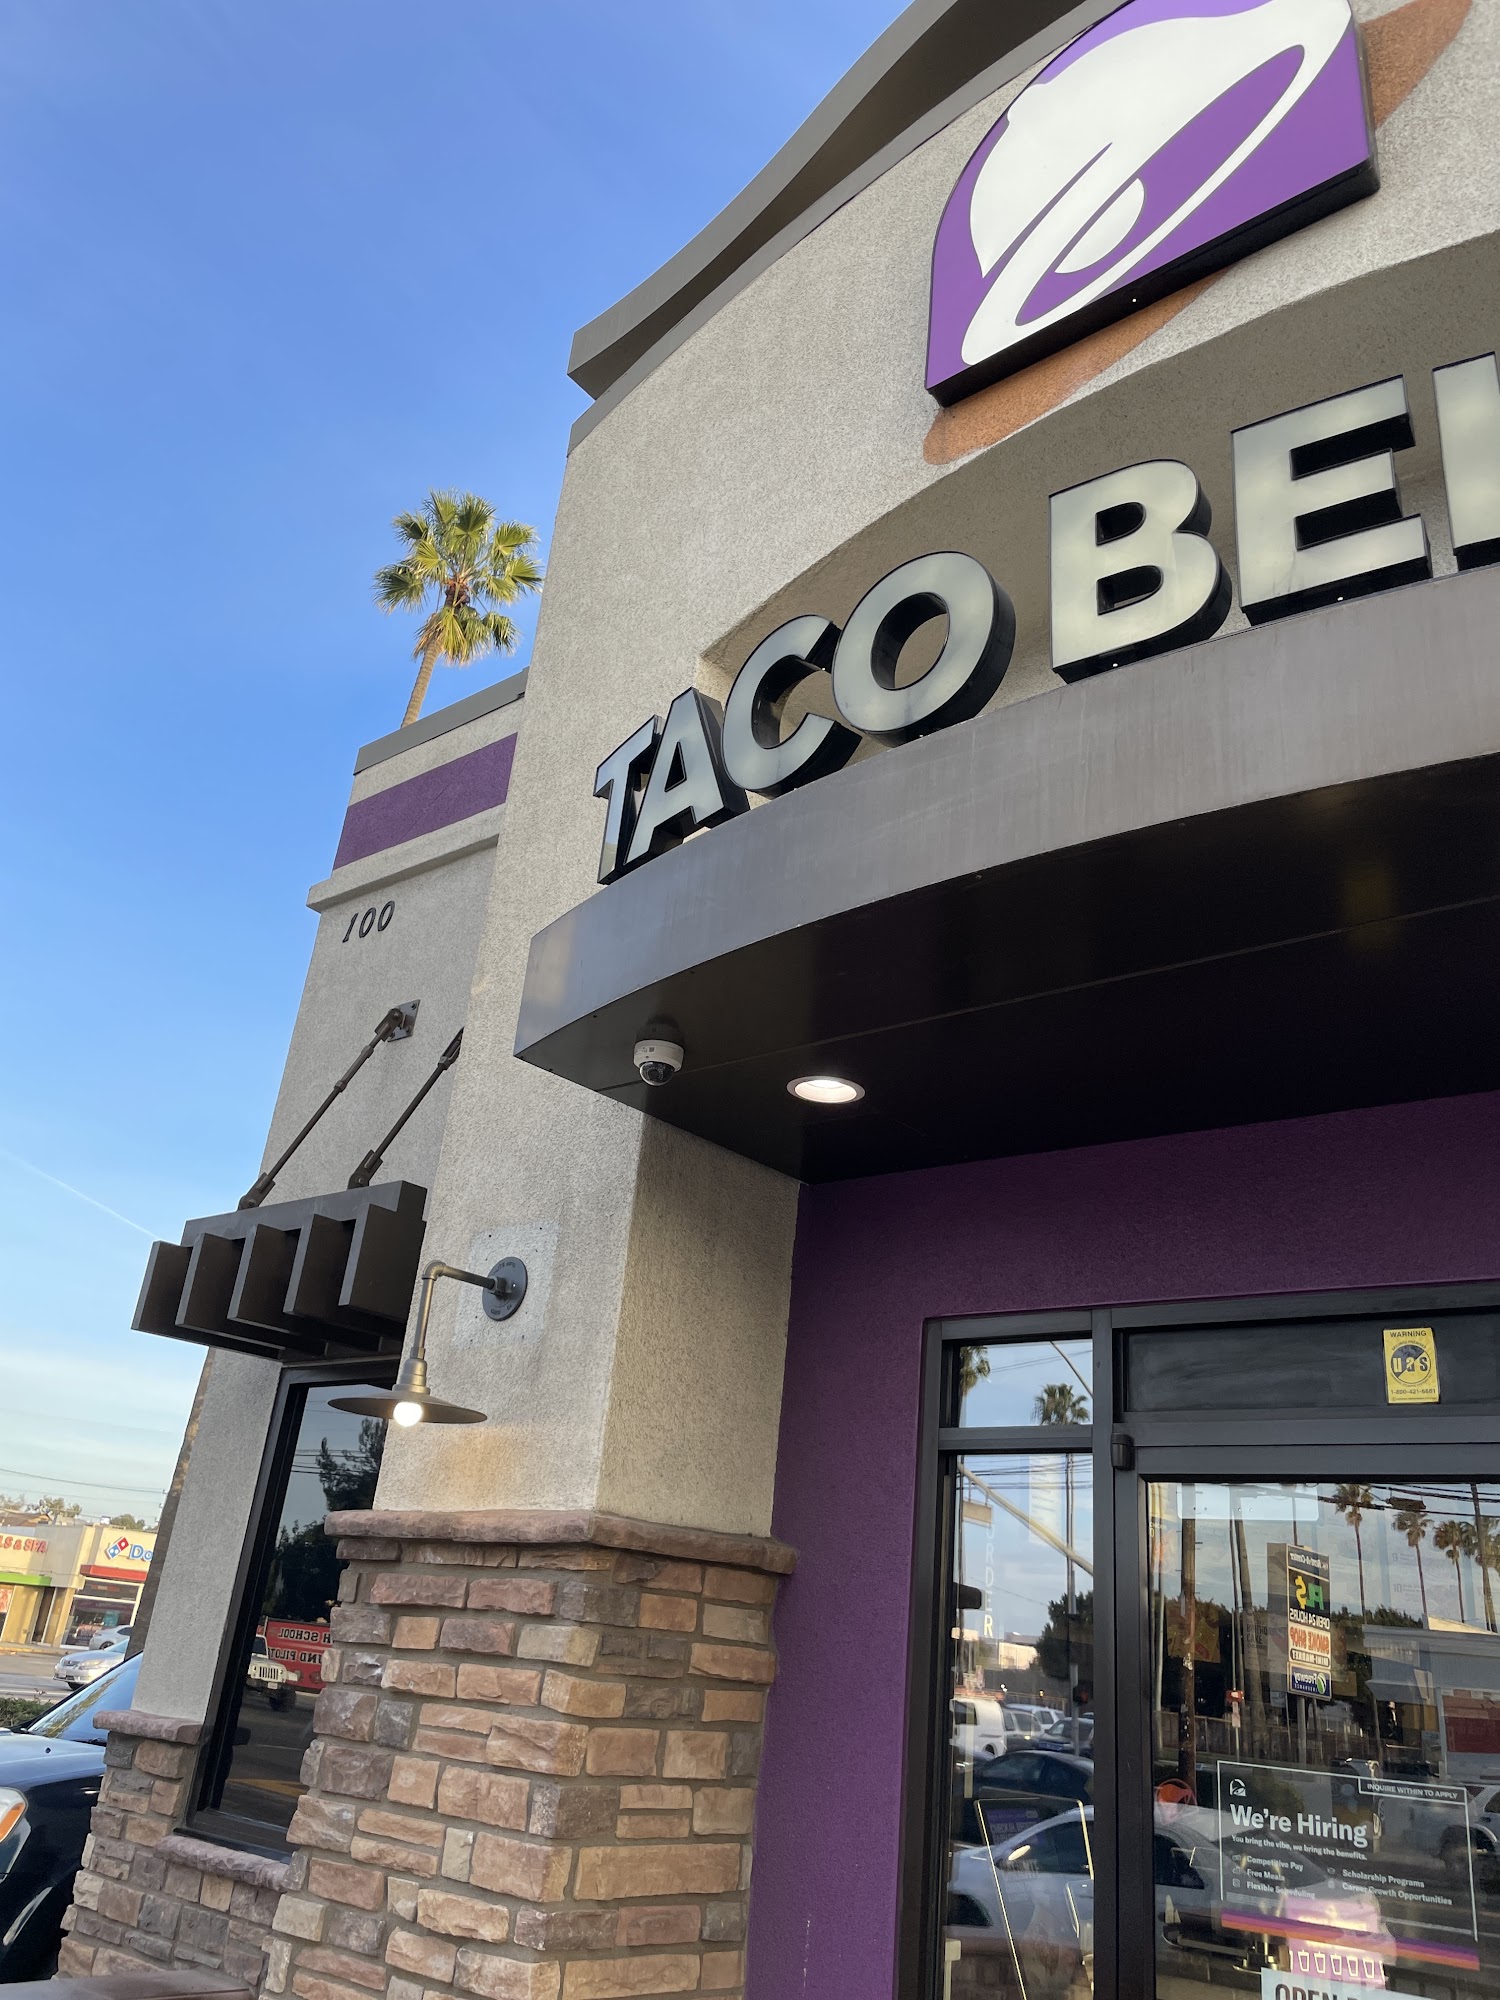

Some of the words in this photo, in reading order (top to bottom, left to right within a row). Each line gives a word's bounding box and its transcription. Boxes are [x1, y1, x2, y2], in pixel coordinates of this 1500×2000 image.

[594, 550, 1014, 885] TACO
[342, 900, 396, 943] 100
[1390, 1330, 1427, 1338] WARNING
[23, 1538, 48, 1553] SPA
[1367, 1783, 1395, 1793] INQUIRE
[1396, 1786, 1423, 1796] WITHIN
[1424, 1789, 1434, 1797] TO
[1435, 1791, 1458, 1799] APPLY
[1230, 1803, 1291, 1833] We're
[1297, 1812, 1368, 1848] Hiring
[1231, 1835, 1244, 1844] You
[1244, 1836, 1262, 1847] bring
[1263, 1839, 1274, 1847] the
[1275, 1840, 1292, 1851] vibe,
[1303, 1844, 1323, 1856] bring
[1323, 1847, 1335, 1856] the
[1335, 1848, 1367, 1860] benefits.
[1247, 1855, 1289, 1868] Competitive
[1290, 1861, 1304, 1872] Pay
[1246, 1868, 1262, 1878] Free
[1264, 1871, 1286, 1881] Meals
[1342, 1869, 1387, 1884] Scholarship
[1388, 1875, 1425, 1888] Programs
[1246, 1881, 1275, 1893] Flexible
[1275, 1887, 1316, 1900] Scheduling
[1342, 1882, 1368, 1893] Career
[1368, 1885, 1397, 1898] Growth
[1398, 1890, 1453, 1906] Opportunities
